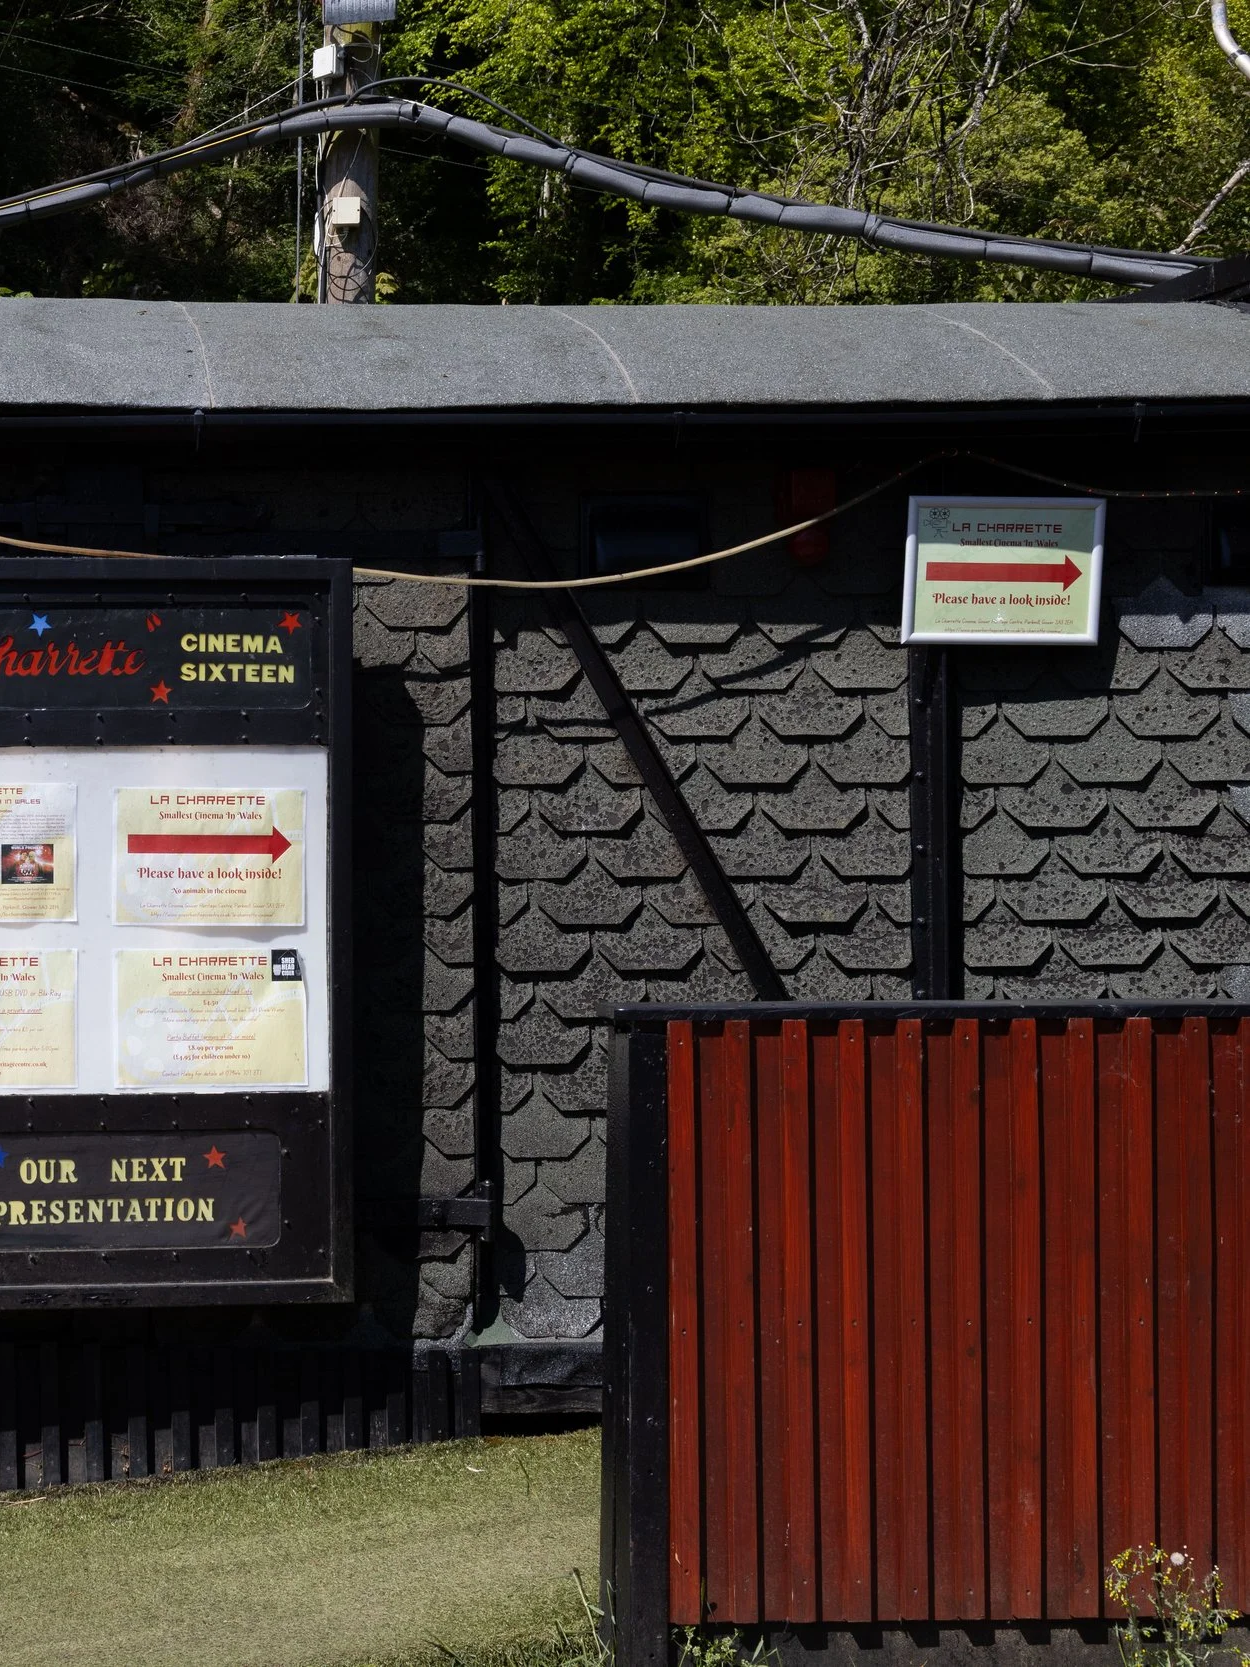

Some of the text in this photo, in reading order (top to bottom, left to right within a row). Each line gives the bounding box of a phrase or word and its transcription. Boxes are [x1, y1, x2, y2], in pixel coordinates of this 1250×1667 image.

[952, 523, 1062, 533] LA CHARRETTE
[960, 538, 1058, 547] Smallest Cinema In Wales
[932, 593, 1070, 607] Please have a look inside!
[180, 633, 283, 654] CINEMA
[179, 662, 295, 684] SIXTEEN
[150, 796, 265, 805] LA CHARRETTE
[159, 811, 262, 820] Smallest Cinema In Wales
[137, 868, 174, 878] Please
[178, 868, 205, 878] have
[218, 868, 244, 881] look
[246, 868, 282, 880] inside!
[153, 957, 267, 966] LA CHARRETTE
[10, 973, 36, 982] Wales
[162, 972, 264, 981] Smallest Cinema In Wales
[20, 1157, 186, 1184] OUR NEXT
